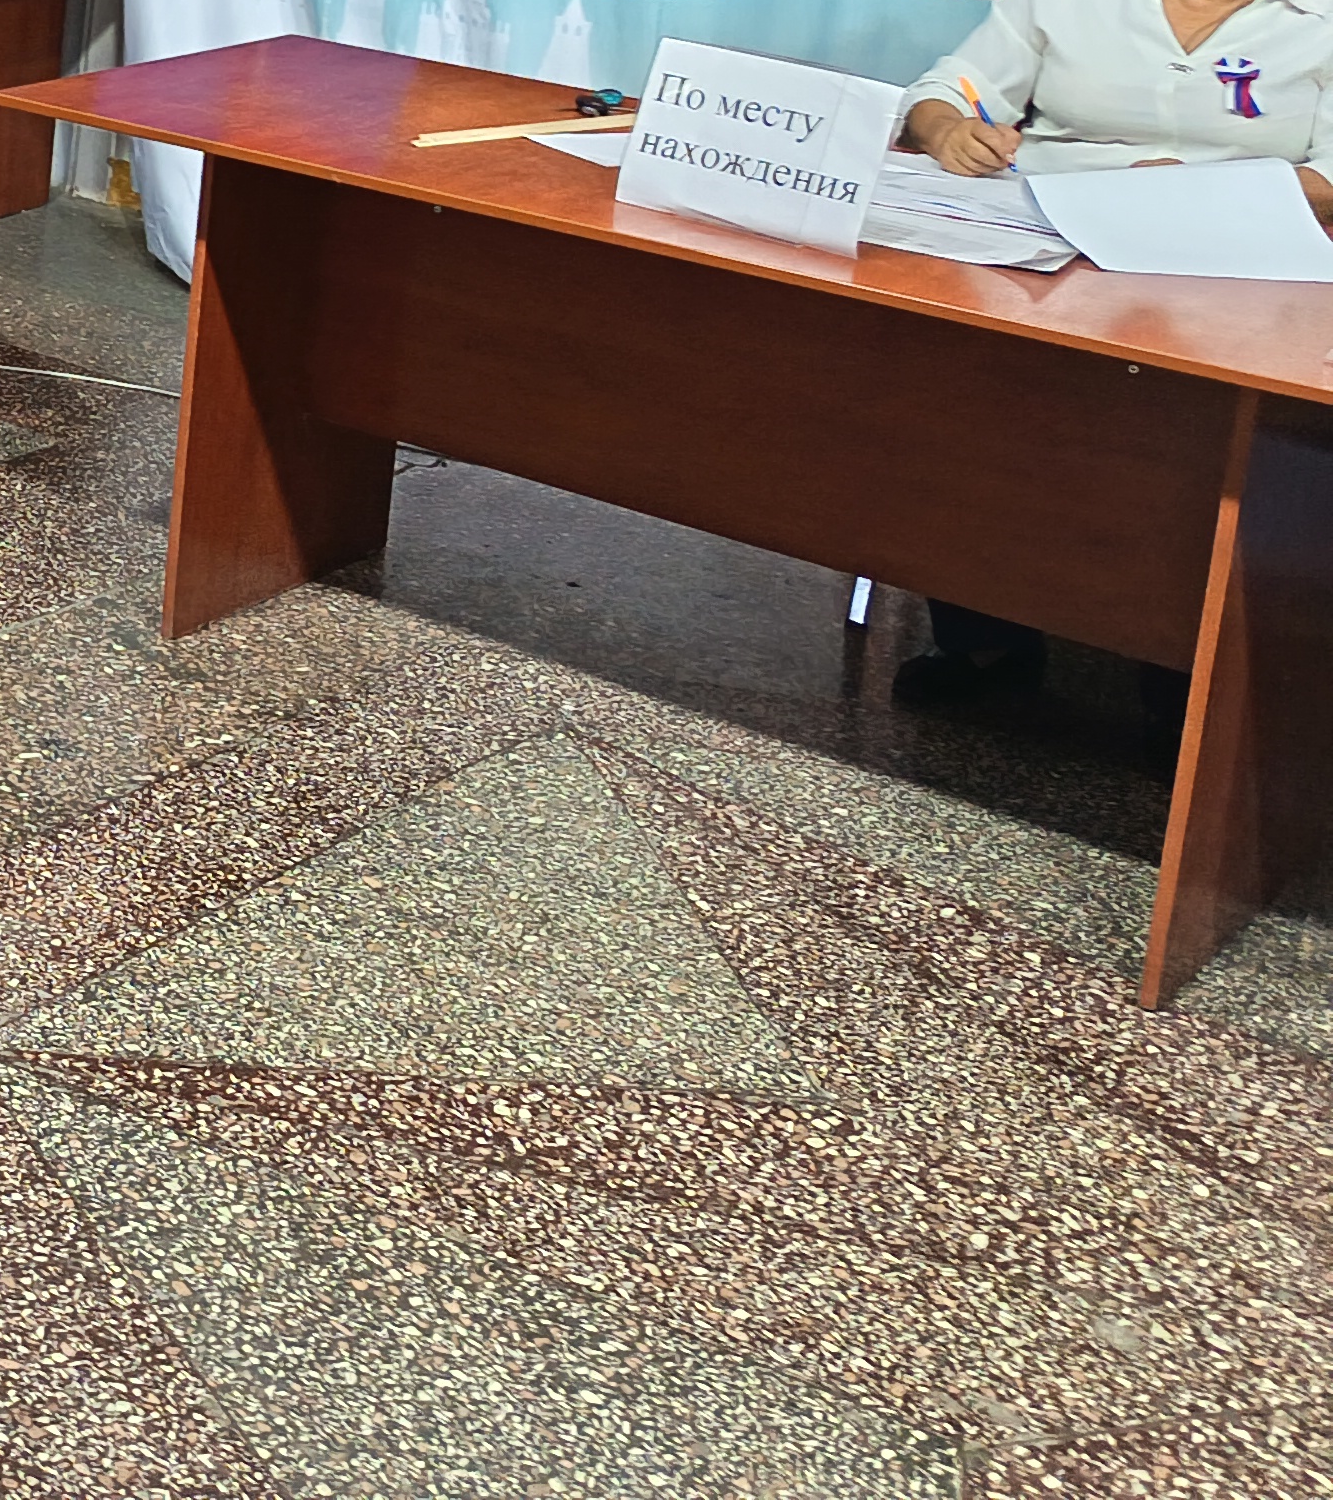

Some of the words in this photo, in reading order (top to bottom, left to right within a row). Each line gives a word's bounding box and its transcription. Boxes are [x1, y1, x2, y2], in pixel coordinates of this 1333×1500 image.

[654, 72, 706, 111] По
[715, 94, 827, 143] месту
[638, 131, 861, 205] нахождения
